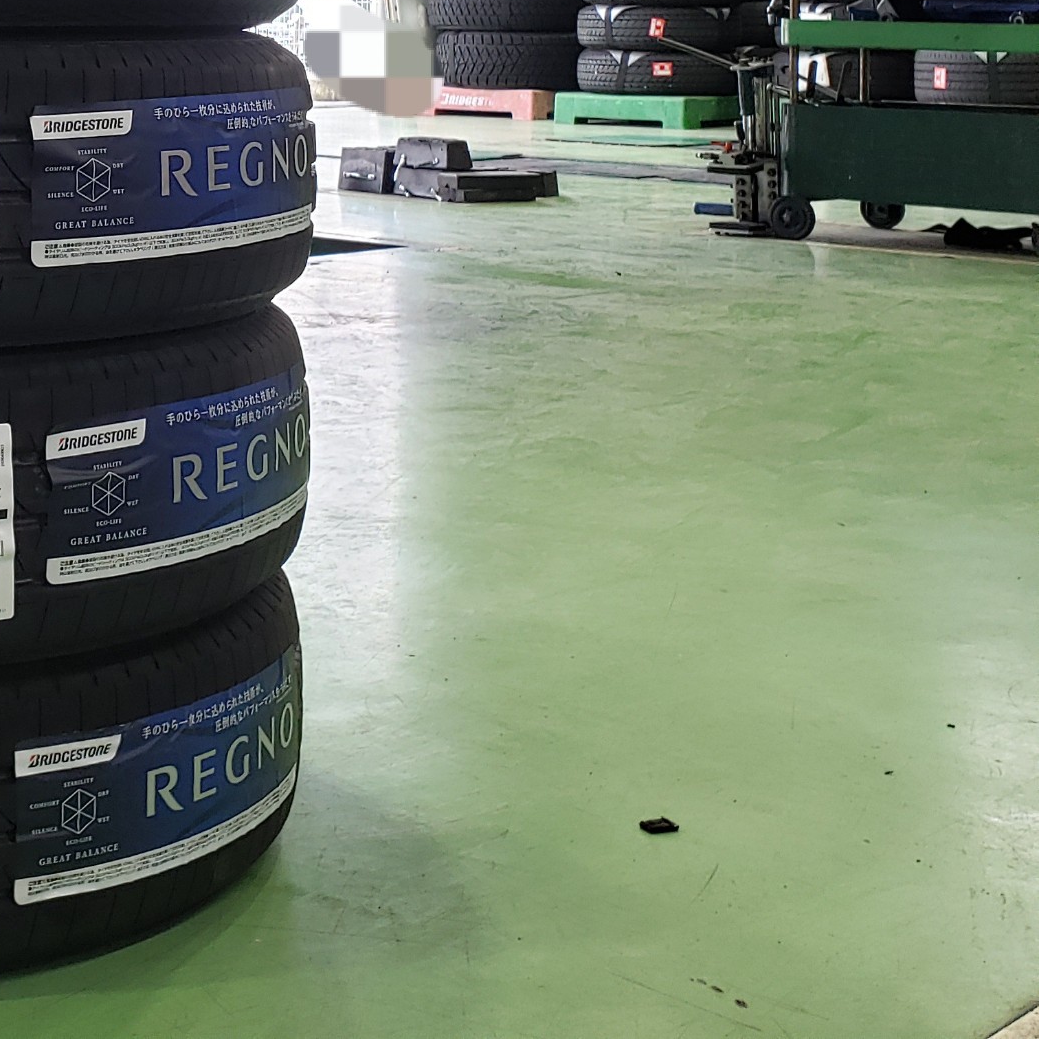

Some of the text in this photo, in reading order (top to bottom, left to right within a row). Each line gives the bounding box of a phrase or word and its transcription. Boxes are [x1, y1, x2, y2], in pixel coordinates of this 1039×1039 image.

[43, 117, 124, 133] BRIDGESTONE
[161, 134, 308, 197] REGNO
[55, 217, 135, 230] GREAT BALANCE
[58, 427, 138, 451] BRIDGESTONE
[172, 413, 306, 504] REGNO
[70, 527, 148, 546] GREAT BALANCE
[28, 743, 112, 768] BRIDGESTONE
[146, 702, 293, 818] REGNO
[39, 843, 119, 866] GREAT BALANCE
